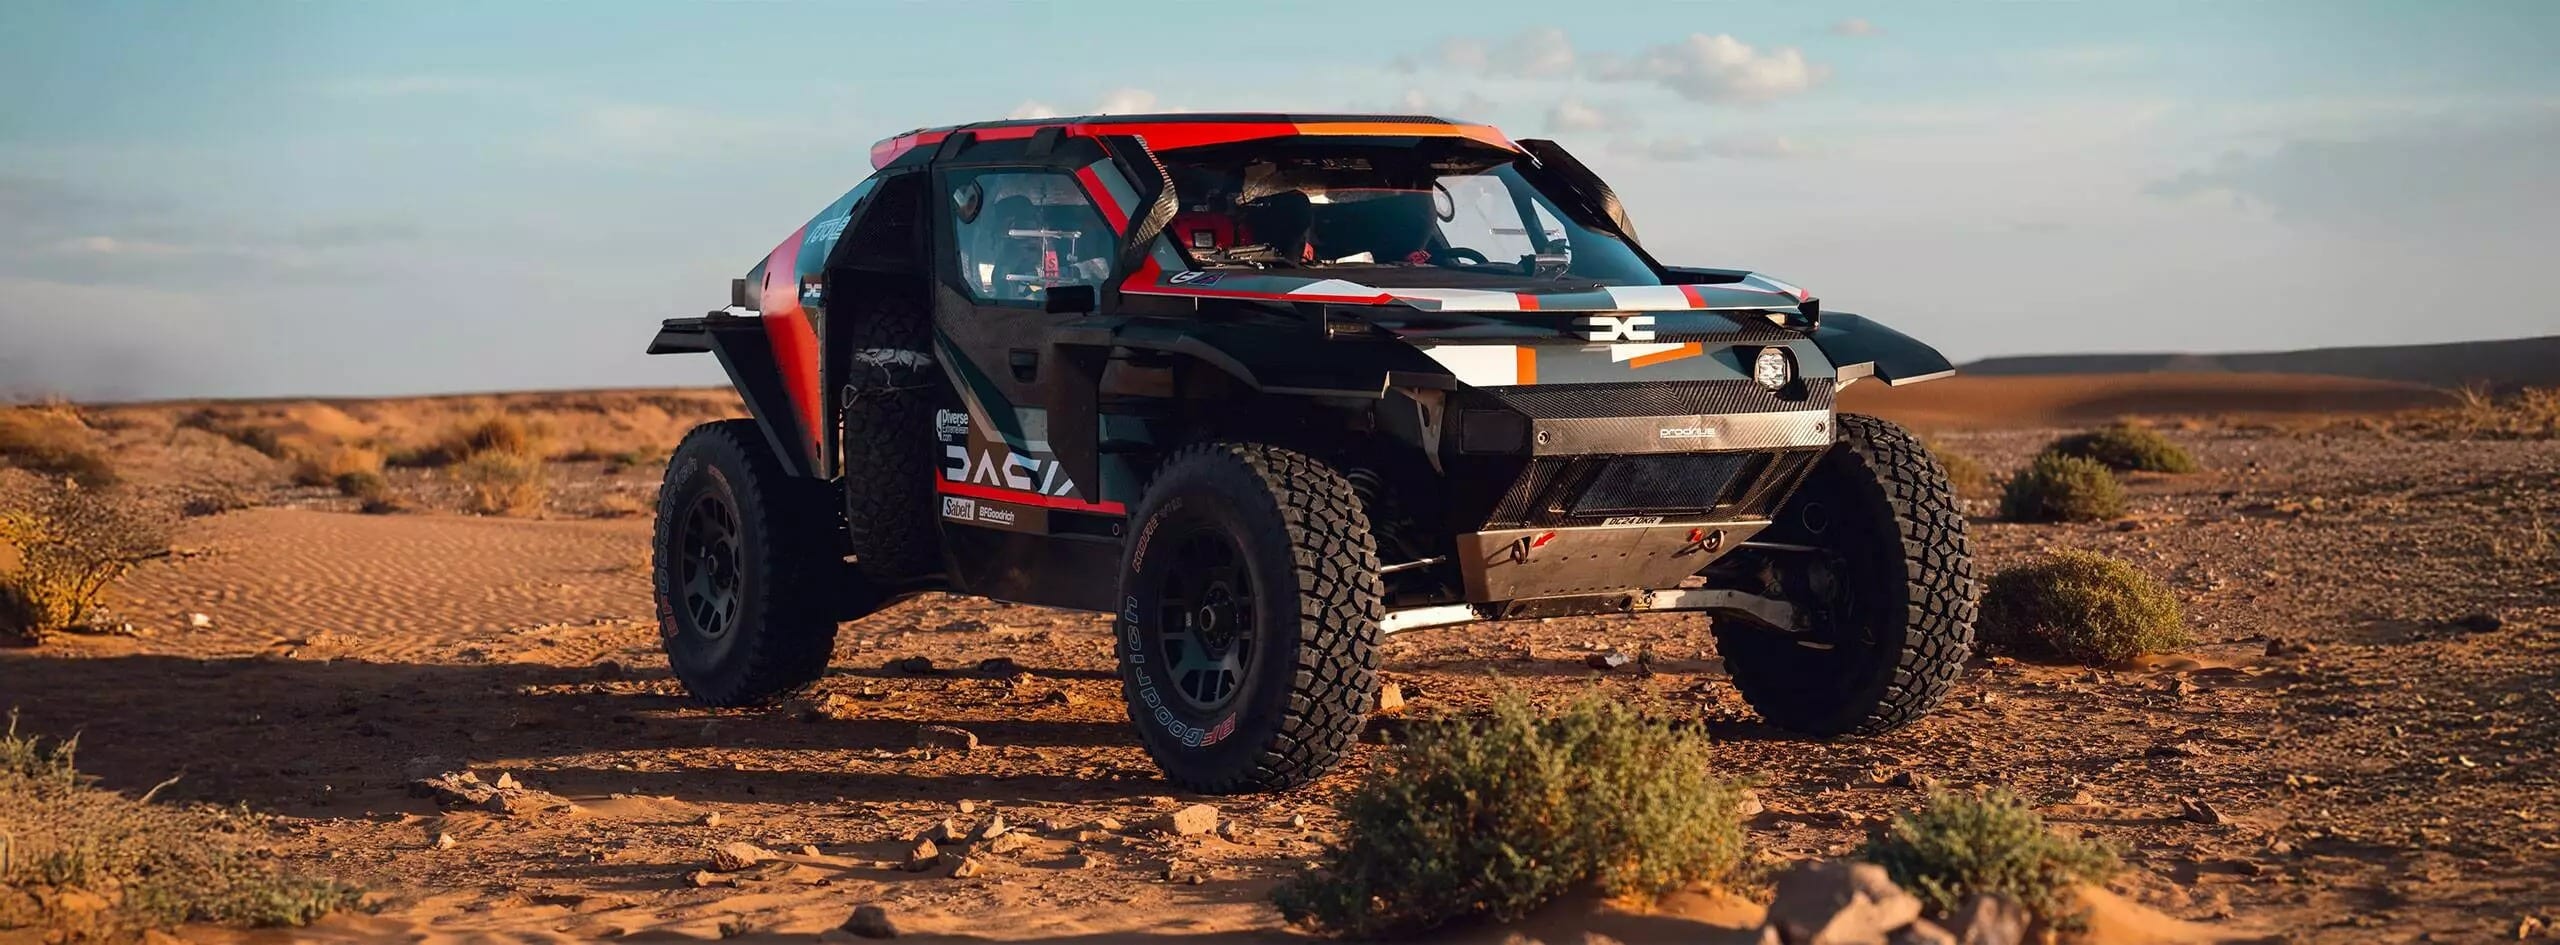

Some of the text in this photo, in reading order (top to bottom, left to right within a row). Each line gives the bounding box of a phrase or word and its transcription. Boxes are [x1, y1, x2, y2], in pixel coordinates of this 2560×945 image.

[942, 409, 969, 426] Diverse
[1660, 427, 1718, 438] prodrive
[945, 498, 972, 519] Sabelt
[978, 506, 1015, 522] BFGoodrich
[1636, 517, 1659, 525] DKR
[1125, 595, 1237, 748] BFGoodrich
